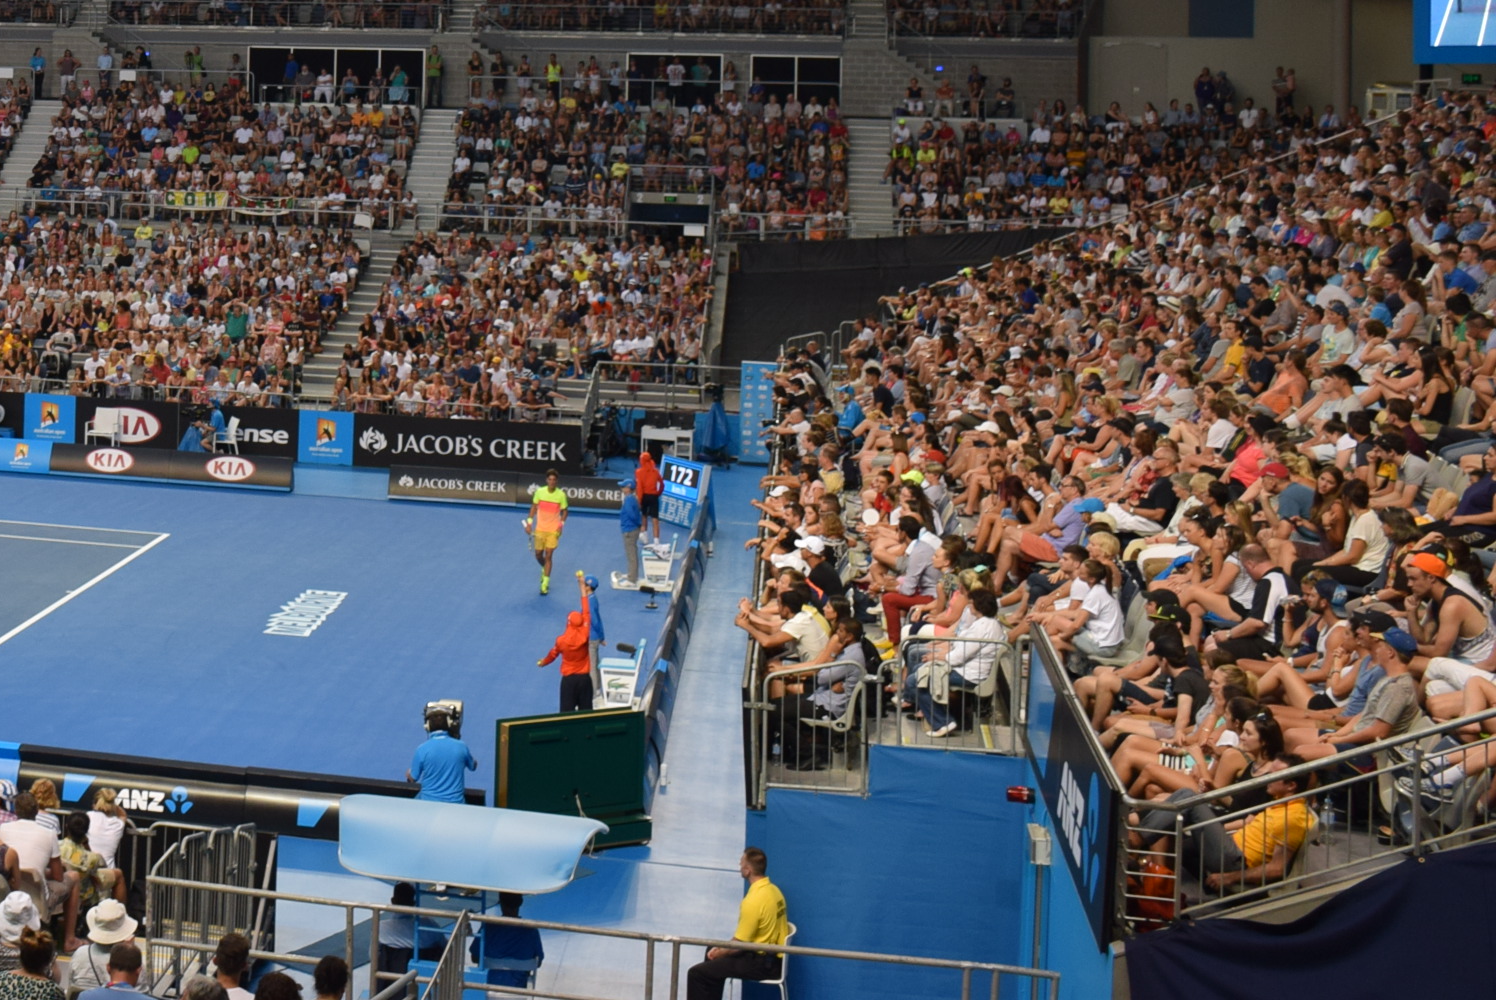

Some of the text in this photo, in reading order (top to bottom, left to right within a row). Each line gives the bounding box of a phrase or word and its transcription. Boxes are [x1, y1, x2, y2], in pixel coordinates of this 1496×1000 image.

[123, 415, 150, 436] IA
[235, 426, 289, 445] ense
[392, 433, 567, 462] JACOB'S CREEK
[94, 453, 126, 468] KIA
[213, 461, 247, 476] KIA
[415, 477, 506, 493] JACOB'S CREEK
[670, 465, 693, 486] 172
[596, 489, 624, 502] CRE
[658, 495, 692, 526] IBM
[114, 788, 165, 813] ANZ
[1056, 761, 1085, 868] ANZ
